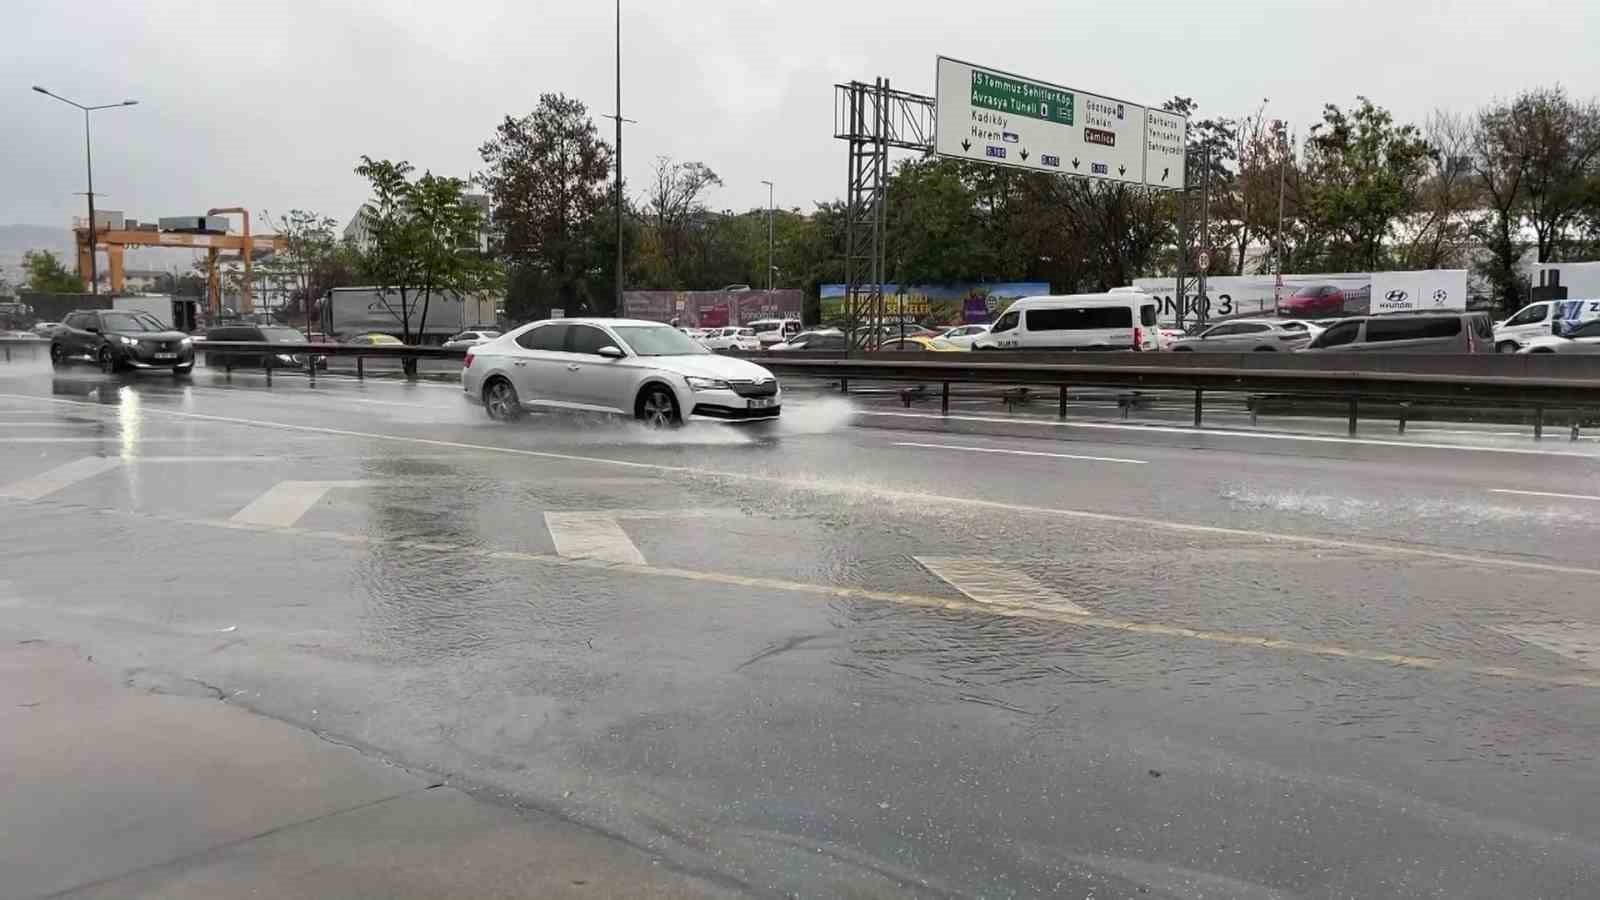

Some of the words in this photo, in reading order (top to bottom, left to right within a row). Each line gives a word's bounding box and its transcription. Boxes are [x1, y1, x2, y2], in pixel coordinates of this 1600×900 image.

[973, 72, 982, 85] 15
[984, 75, 1022, 94] Temmuz
[972, 91, 1008, 109] Avrasya
[1010, 97, 1038, 113] Tüneli
[971, 125, 1001, 141] Harem
[1218, 294, 1233, 315] 3
